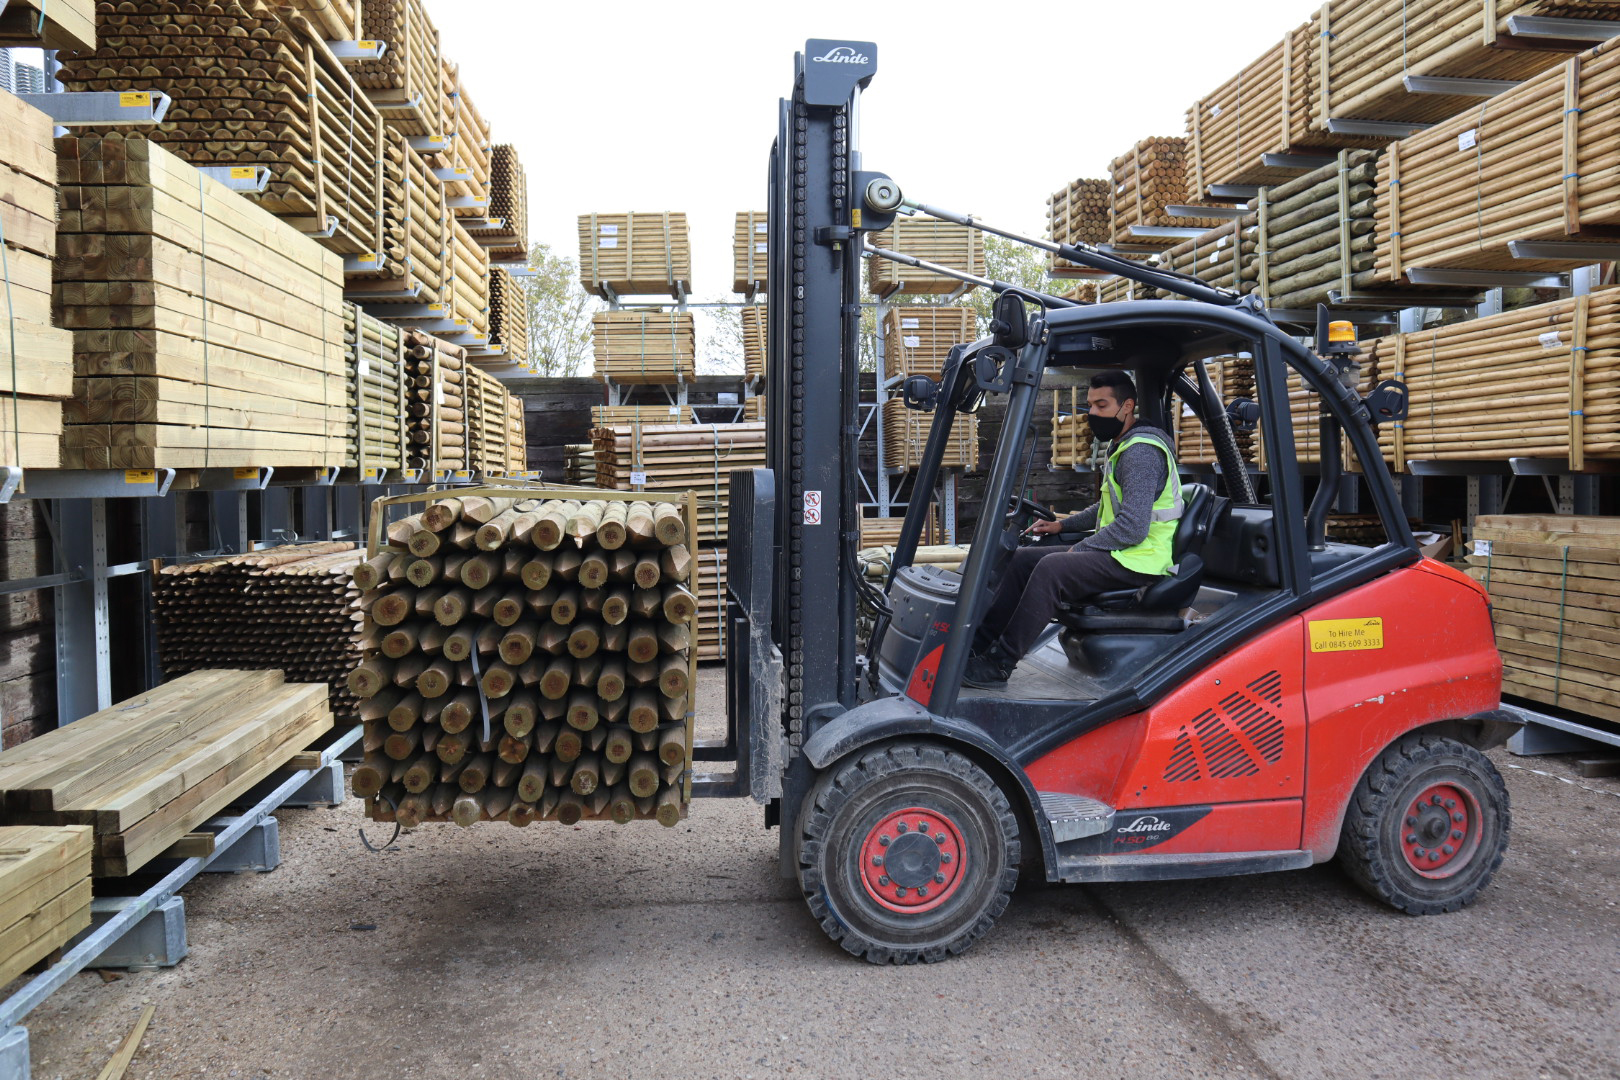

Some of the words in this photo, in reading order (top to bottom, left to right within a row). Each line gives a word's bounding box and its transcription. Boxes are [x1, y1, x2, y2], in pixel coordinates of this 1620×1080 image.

[813, 46, 869, 65] Linde
[1329, 630, 1337, 638] To
[1339, 629, 1353, 637] Hire
[1355, 628, 1366, 636] Me
[1315, 640, 1327, 650] Call
[1329, 640, 1347, 649] 0845
[1348, 639, 1362, 648] 609
[1363, 638, 1381, 647] 3333
[1117, 815, 1171, 833] Linde
